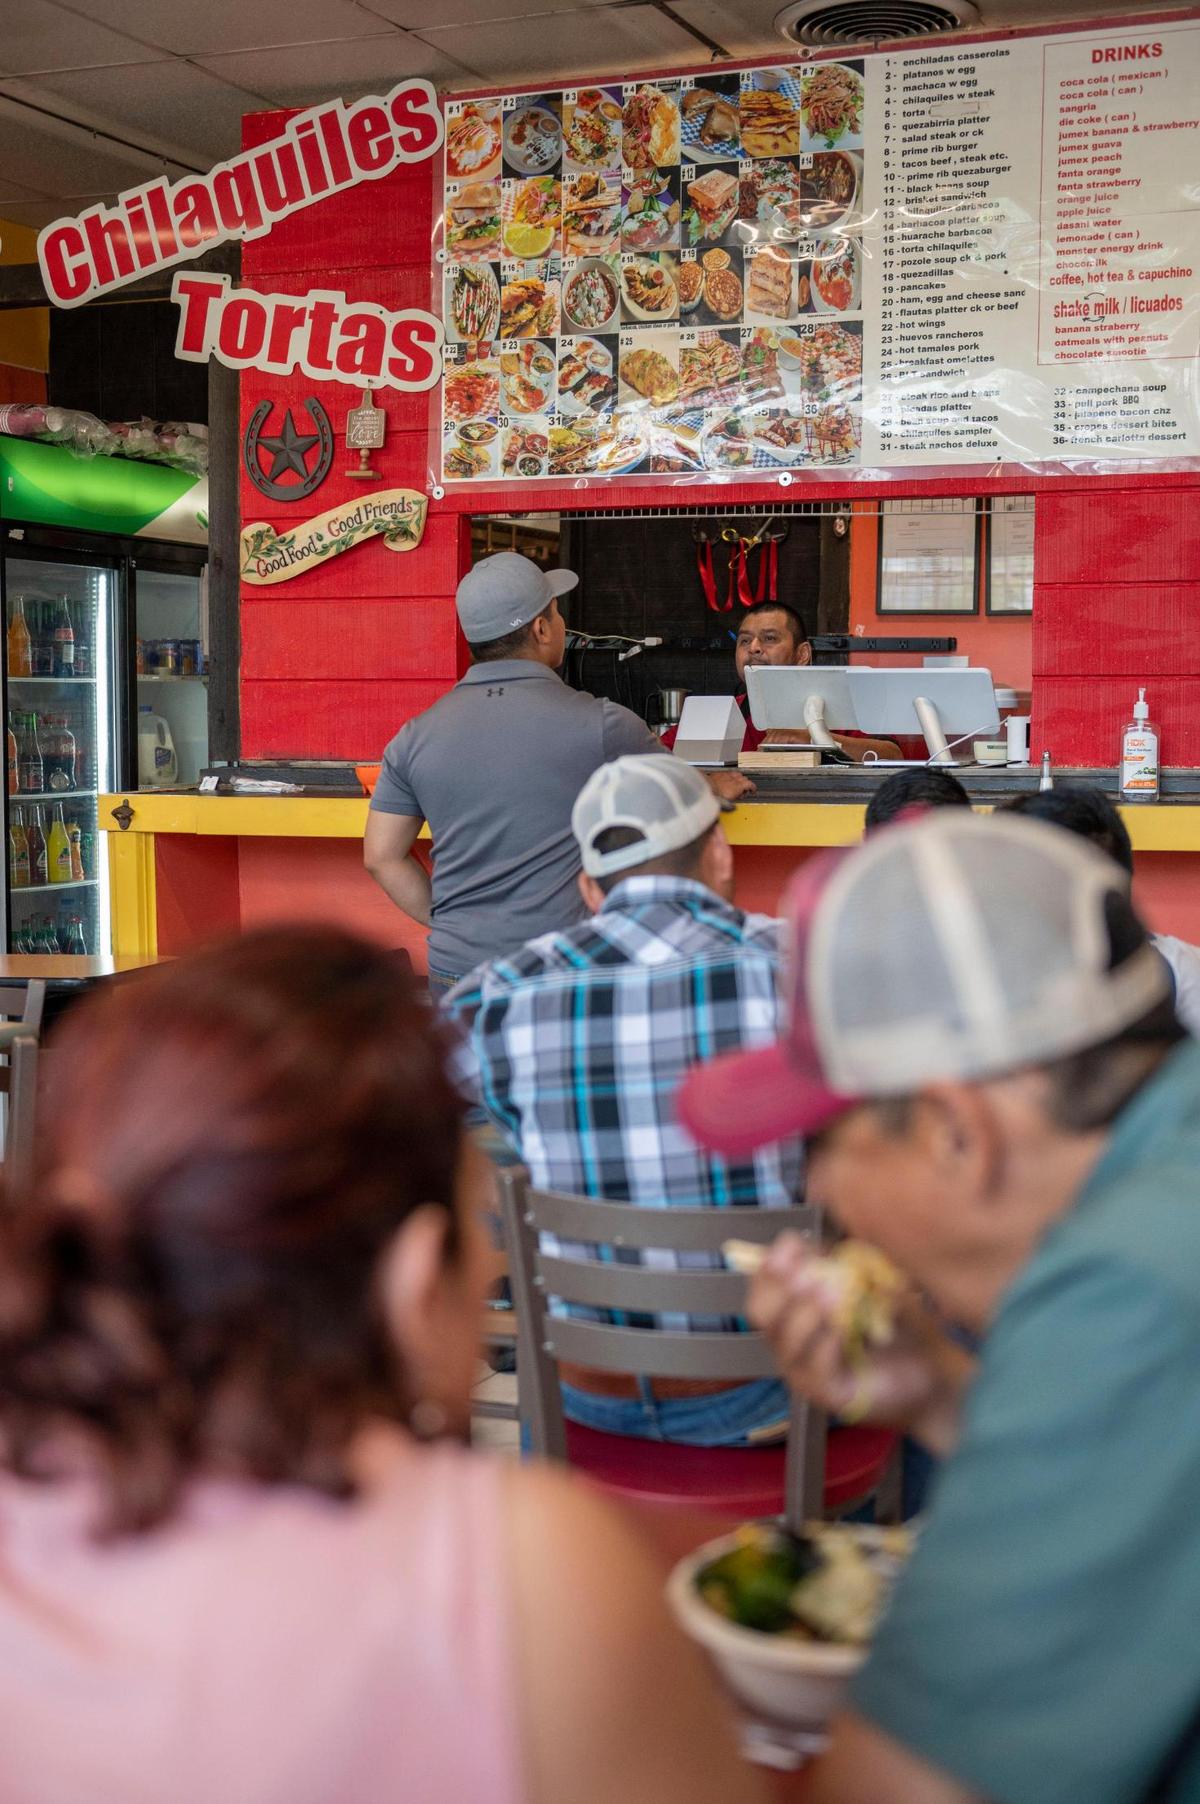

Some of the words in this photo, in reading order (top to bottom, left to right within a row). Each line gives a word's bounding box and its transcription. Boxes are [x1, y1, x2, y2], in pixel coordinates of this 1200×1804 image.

[903, 55, 955, 66] enchiladas
[957, 49, 1010, 61] casserolas
[1092, 43, 1163, 64] DRINKS
[903, 70, 944, 81] platanos
[958, 66, 975, 75] egg
[1060, 79, 1084, 87] coca
[1087, 75, 1109, 85] cola
[1118, 71, 1162, 81] mexican
[903, 82, 946, 92] machaca
[960, 79, 978, 88] egg
[902, 94, 954, 105] chilaquiles
[968, 89, 995, 98] steak
[1059, 92, 1084, 100] coca
[1087, 88, 1108, 97] cola
[1118, 87, 1136, 95] can
[902, 109, 925, 118] torta
[1059, 103, 1096, 113] sangria
[902, 118, 955, 132] quezabirria
[958, 116, 990, 127] platter
[1059, 118, 1074, 126] die
[1077, 116, 1102, 125] coke
[902, 133, 927, 143] salad
[930, 131, 956, 140] steak
[972, 128, 984, 136] ck
[1058, 131, 1089, 141] jumex
[1092, 127, 1129, 136] banana
[1132, 125, 1140, 133] &
[1143, 120, 1200, 132] strawberry
[902, 147, 928, 157] prime
[931, 145, 944, 153] rib
[946, 143, 978, 152] burger
[1058, 144, 1088, 154] jumex
[1091, 141, 1122, 151] guava
[902, 160, 928, 168] tacos
[930, 156, 952, 166] beef
[960, 153, 987, 163] steak
[1058, 157, 1088, 167] jumex
[1091, 153, 1122, 164] peach
[907, 172, 934, 182] prime
[936, 170, 949, 178] rib
[952, 166, 1012, 178] quezaburger
[1057, 169, 1083, 178] fanta
[1086, 167, 1121, 176] orange
[907, 184, 932, 193] black
[966, 180, 989, 188] soup
[1057, 183, 1083, 191] fanta
[1086, 178, 1141, 189] strawberry
[43, 87, 439, 301] Chilaquiles
[1057, 195, 1091, 204] orange
[1094, 193, 1119, 203] juice
[1056, 208, 1084, 218] apple
[1086, 206, 1111, 216] juice
[1093, 219, 1122, 227] water
[901, 231, 945, 241] huarache
[948, 228, 992, 237] barbacoa
[1056, 233, 1105, 243] lemonade
[901, 245, 924, 253] torta
[1056, 247, 1098, 256] monster
[1100, 245, 1135, 253] energy
[1137, 241, 1163, 250] drink
[901, 257, 932, 268] pozole
[959, 254, 971, 262] ck
[985, 251, 1006, 262] pork
[901, 268, 954, 280] quezadillas
[1050, 273, 1084, 286] coffee,
[1087, 272, 1104, 283] hot
[1106, 271, 1124, 282] tea
[1127, 269, 1135, 281] &
[1138, 266, 1192, 282] capuchino
[900, 282, 946, 293] pancakes
[926, 296, 943, 304] egg
[946, 293, 963, 301] and
[966, 292, 1001, 300] cheese
[900, 308, 933, 316] flautas
[935, 306, 968, 316] platter
[970, 304, 982, 312] ck
[997, 302, 1019, 310] beef
[1053, 300, 1090, 318] shake
[1094, 297, 1119, 315] milk
[1130, 294, 1183, 313] licuados
[801, 325, 814, 334] 28
[900, 321, 915, 329] hot
[918, 320, 946, 329] wings
[1055, 326, 1091, 334] banana
[1094, 323, 1140, 332] straberry
[177, 280, 437, 383] Tortas
[741, 328, 753, 338] 27
[936, 331, 984, 339] rancheros
[560, 339, 573, 347] 24
[1054, 337, 1100, 347] oatmeals
[1103, 335, 1125, 344] with
[899, 346, 915, 354] hot
[917, 344, 955, 353] tamales
[958, 342, 980, 352] pork
[1055, 350, 1104, 359] chocolate
[1143, 384, 1167, 392] soup
[1054, 400, 1066, 408] 33
[1096, 398, 1118, 408] pork
[1123, 395, 1139, 405] BBQ
[805, 405, 817, 414] 36
[444, 421, 456, 431] 29
[498, 418, 509, 428] 30
[549, 416, 562, 426] 31
[1053, 423, 1065, 431] 35
[1152, 420, 1177, 428] bites
[954, 427, 992, 436] sampler
[1148, 432, 1186, 441] dessert
[900, 442, 926, 450] steak
[929, 441, 963, 449] nachos
[966, 440, 998, 448] deluxe
[256, 548, 293, 578] Good
[288, 536, 318, 565] Food
[328, 506, 363, 537] Good
[364, 496, 413, 521] Friends
